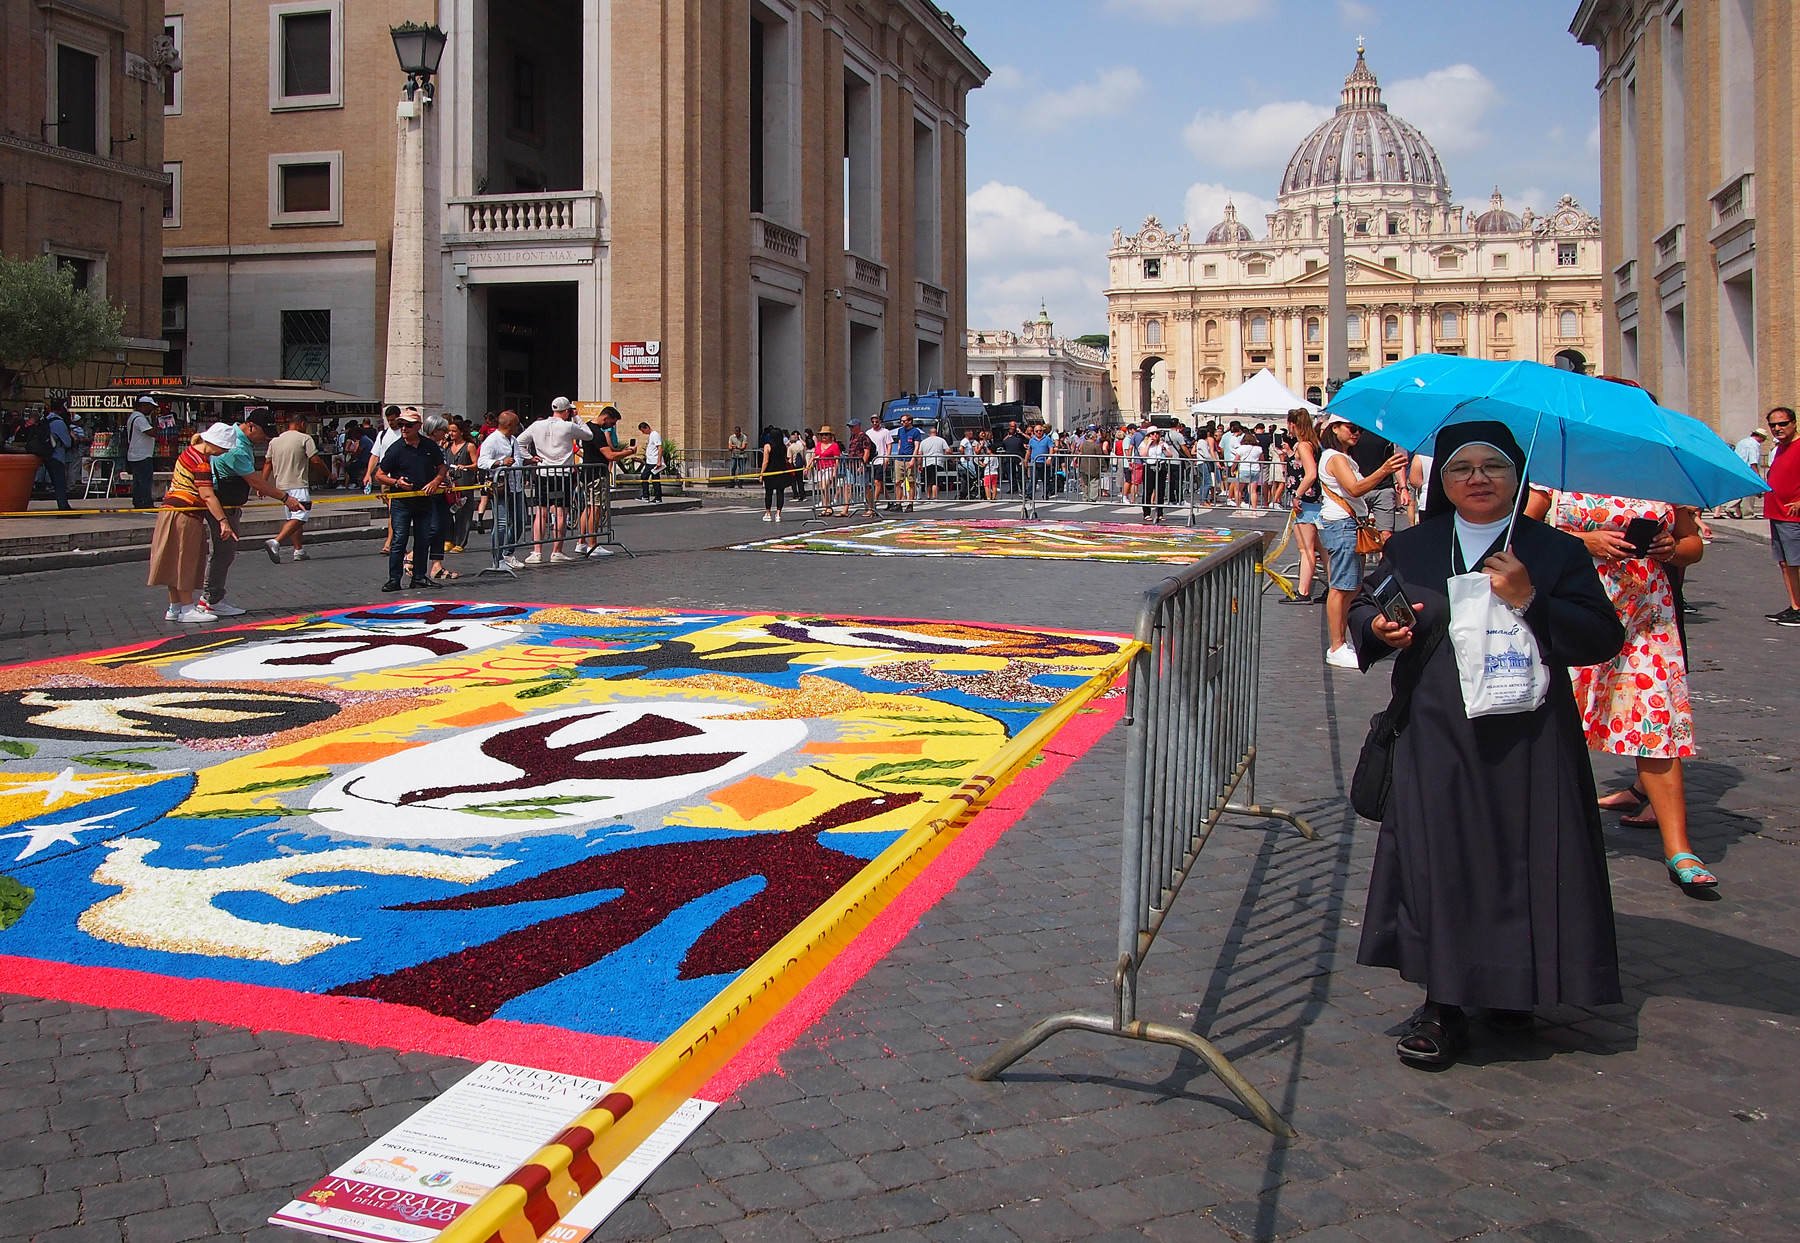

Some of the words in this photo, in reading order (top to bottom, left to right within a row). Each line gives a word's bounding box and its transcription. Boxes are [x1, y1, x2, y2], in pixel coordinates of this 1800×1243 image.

[622, 356, 635, 365] SAN
[635, 356, 659, 365] LORENZO
[113, 377, 122, 385] LA
[124, 377, 150, 385] STORIA
[151, 377, 159, 385] DI
[161, 377, 182, 385] ROMA
[326, 403, 376, 415] GELATI
[489, 1063, 602, 1092] INFIORATA
[477, 1074, 495, 1082] DI
[502, 1076, 567, 1096] ROMA
[490, 1086, 517, 1095] DELLO
[518, 1091, 550, 1100] SPIRITO
[402, 1146, 427, 1155] LOCO
[438, 1153, 501, 1170] FERMIGNANO
[324, 1178, 459, 1216] INFIORATA
[351, 1196, 388, 1209] DELLE
